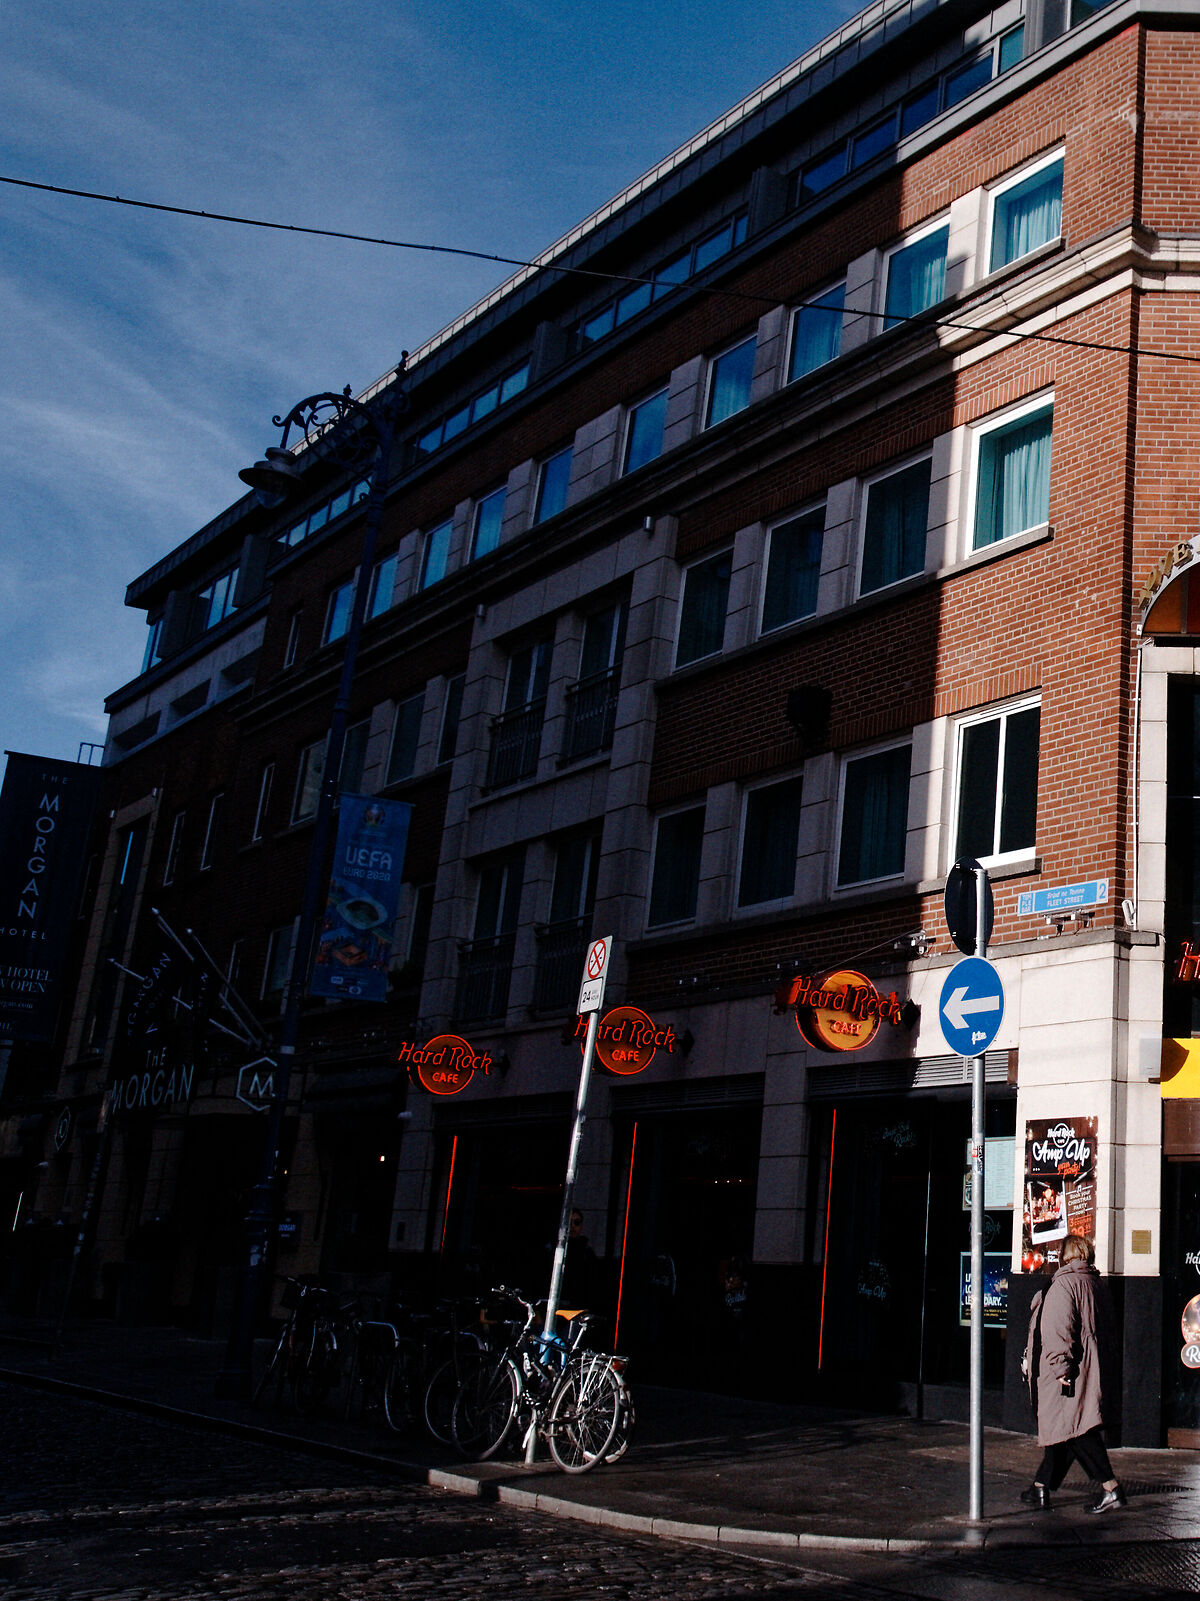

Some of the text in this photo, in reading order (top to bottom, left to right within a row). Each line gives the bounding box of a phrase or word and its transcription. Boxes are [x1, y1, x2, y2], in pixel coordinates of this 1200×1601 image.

[17, 793, 60, 920] MORGAN
[346, 846, 393, 870] UEFA
[1047, 895, 1084, 907] FLEET STREET
[1099, 882, 1107, 899] 2
[7, 965, 53, 982] HOTEL
[10, 979, 47, 993] OPEN
[788, 976, 901, 1026] Hard Rock
[629, 1019, 676, 1053] Rock
[145, 1046, 167, 1069] THE
[398, 1041, 492, 1075] Hard Rock
[611, 1049, 640, 1062] CAFE
[111, 1063, 195, 1114] MORGAN
[432, 1071, 459, 1084] CAFE
[1032, 1138, 1091, 1168] Amp Up
